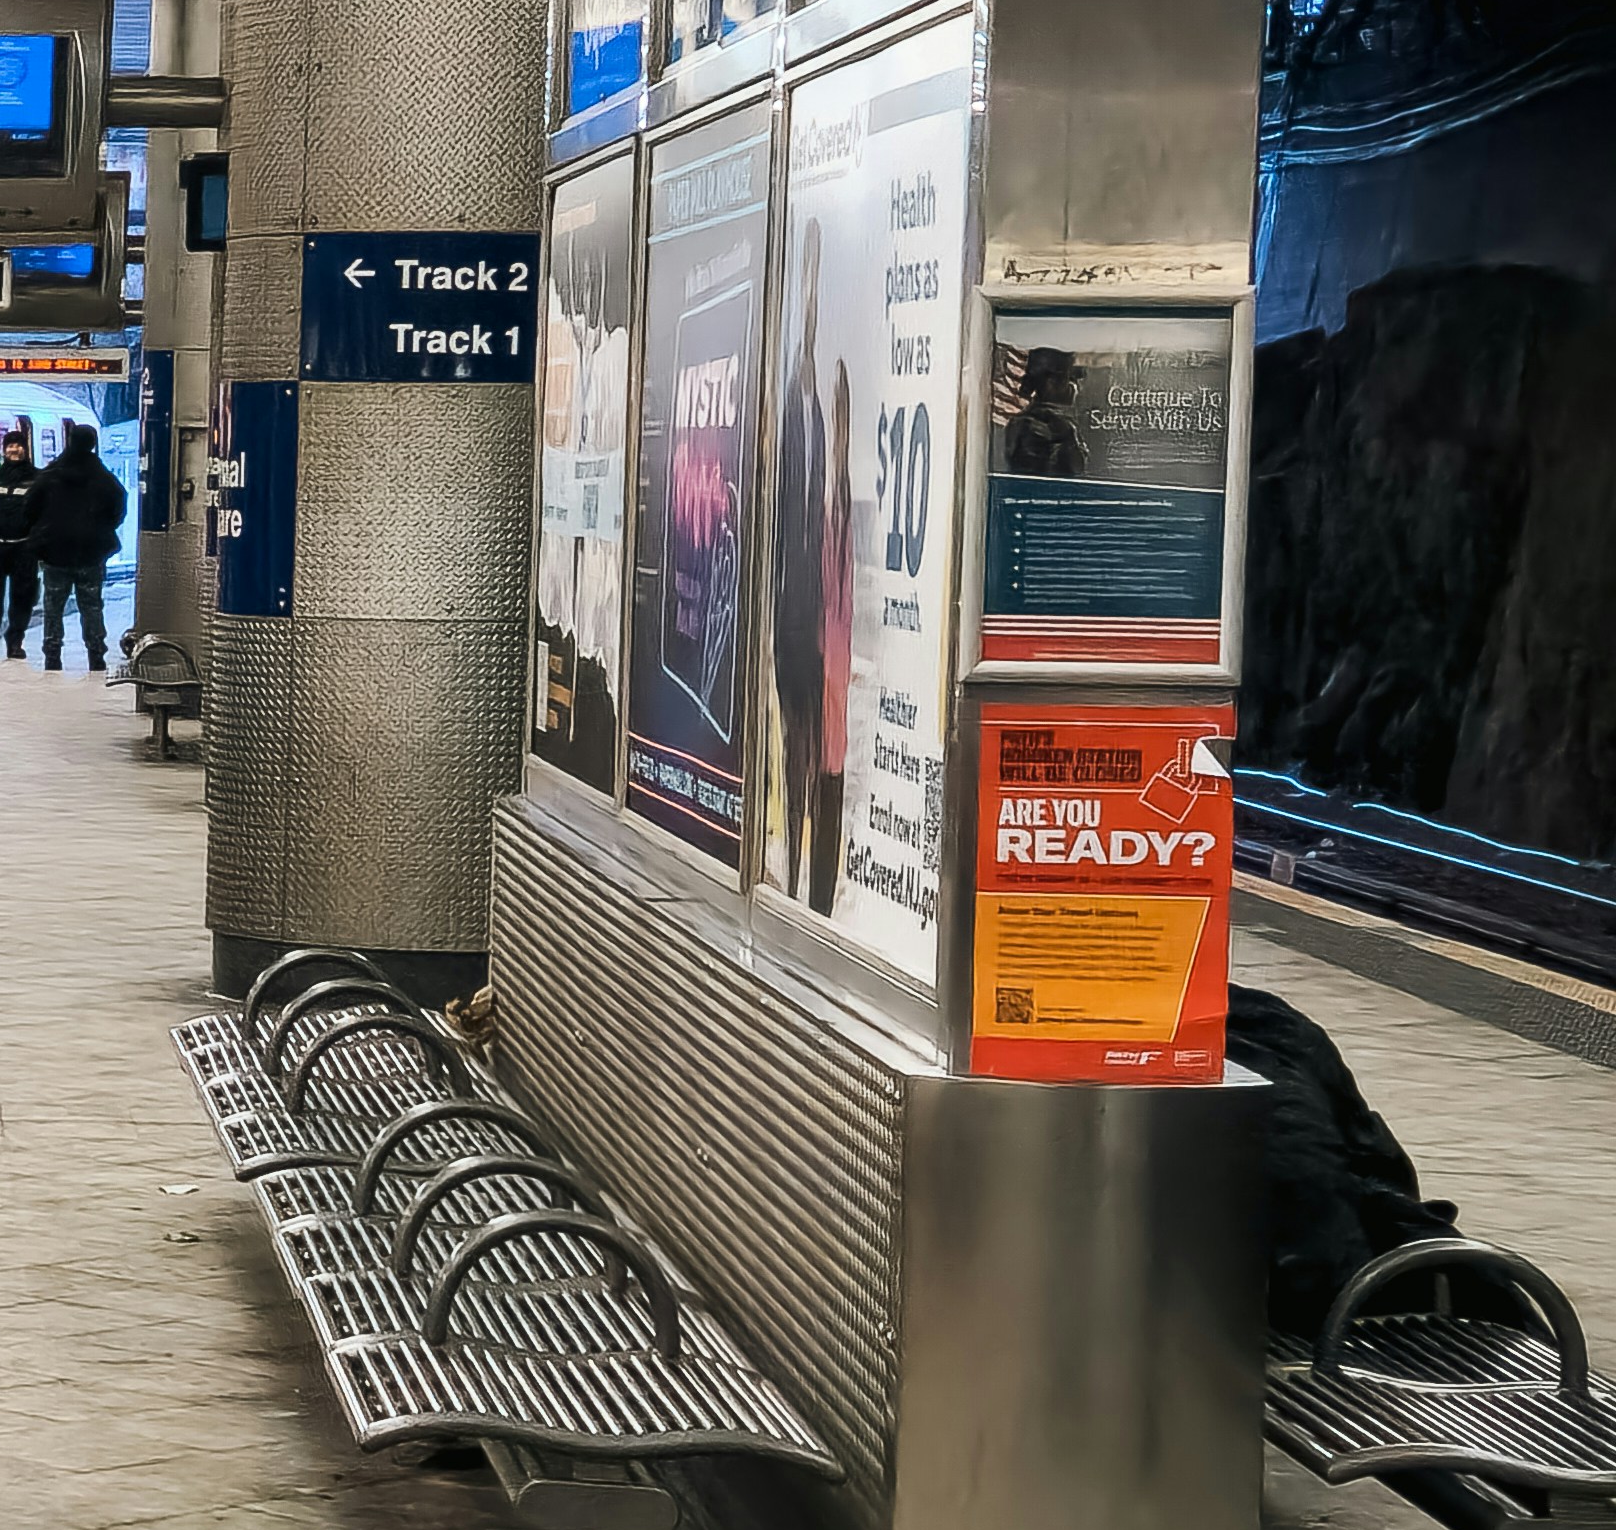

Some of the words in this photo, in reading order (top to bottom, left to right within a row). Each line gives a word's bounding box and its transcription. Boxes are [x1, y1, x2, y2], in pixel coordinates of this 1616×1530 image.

[890, 171, 936, 231] Health
[394, 258, 498, 291] Track
[508, 262, 529, 292] 2
[885, 251, 921, 320] plans
[921, 259, 940, 301] as
[389, 324, 493, 355] Track
[504, 326, 519, 355] 1
[890, 323, 915, 376] low
[916, 335, 932, 375] as
[676, 354, 740, 428] MYSTIC
[1107, 384, 1193, 408] Continue
[1200, 387, 1222, 408] To
[1089, 407, 1142, 431] Serve
[1147, 408, 1193, 431] With
[1198, 409, 1225, 431] Us
[876, 402, 931, 579] $10
[873, 732, 900, 777] Starts
[900, 740, 920, 785] Here
[869, 792, 893, 837] Enroll
[893, 813, 911, 846] now
[911, 816, 921, 850] at
[998, 798, 1051, 827] ARE
[1053, 799, 1101, 828] YOU
[995, 828, 1216, 866] READY?
[846, 837, 938, 931] GetCovered.NJ.go
